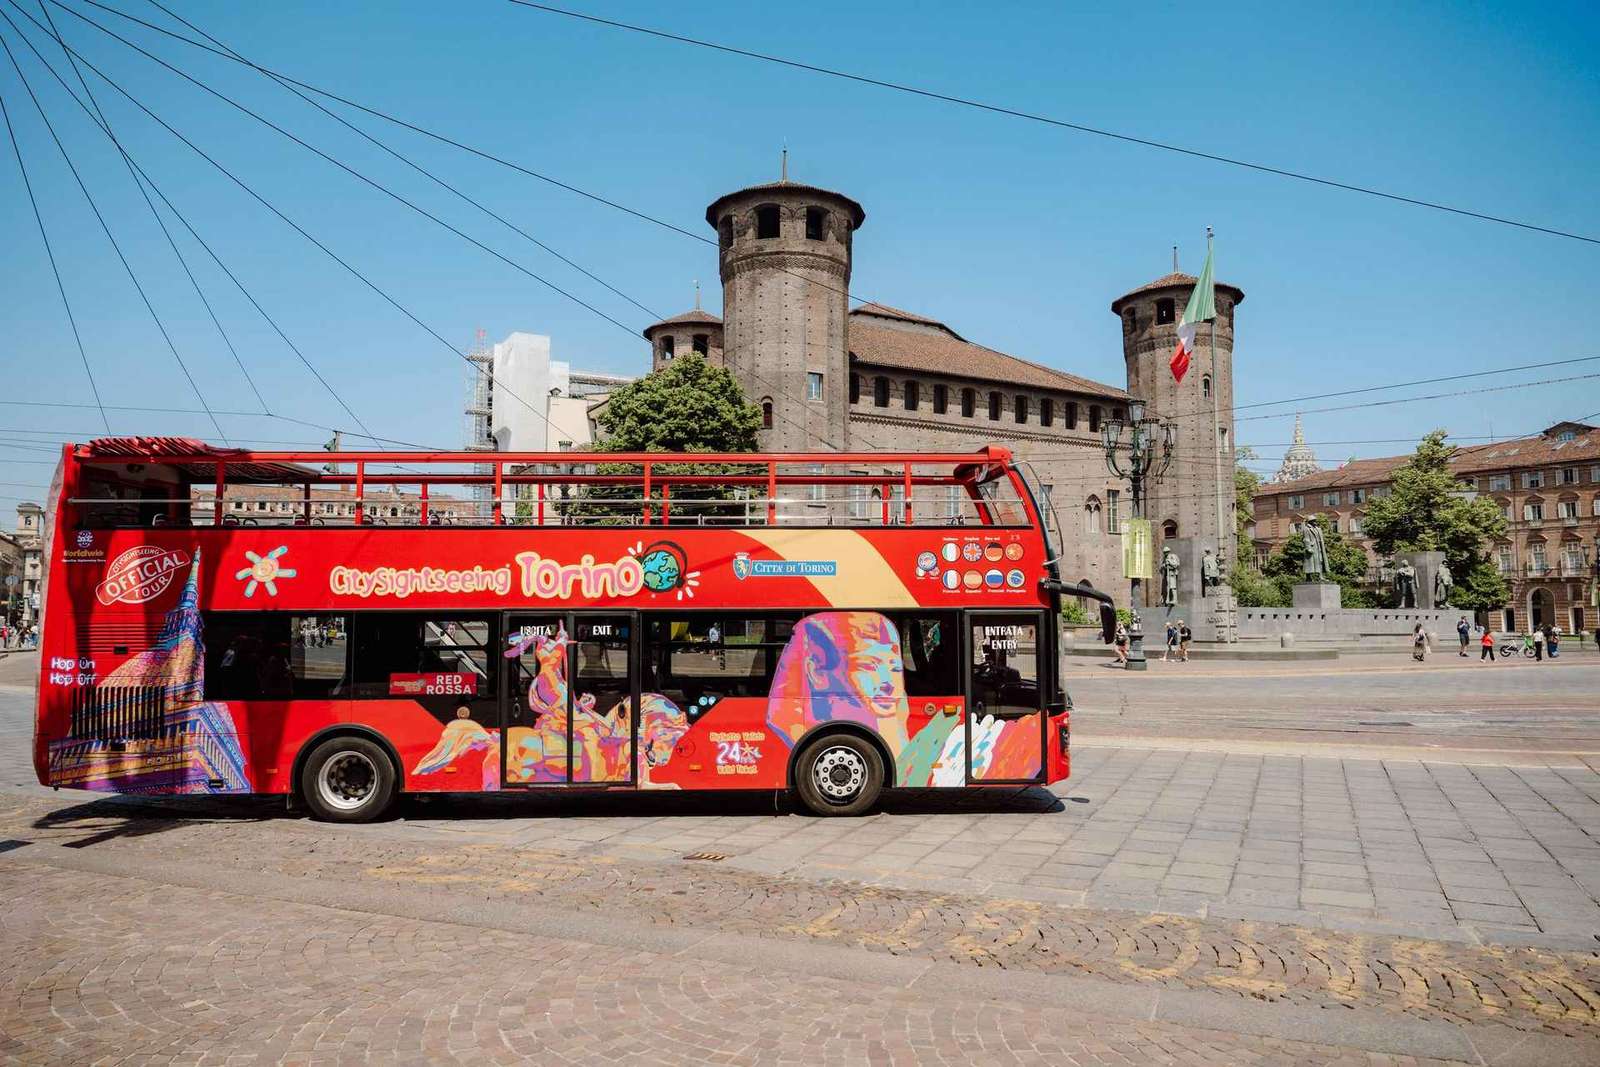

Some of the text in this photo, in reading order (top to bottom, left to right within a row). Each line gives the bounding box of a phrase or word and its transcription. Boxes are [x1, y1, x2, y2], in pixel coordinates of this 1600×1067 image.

[105, 553, 184, 598] OFFICIAL
[330, 551, 644, 599] CitySightseeing Torino
[134, 577, 169, 598] TOUR
[592, 625, 612, 636] EXIT
[991, 639, 1018, 650] ENTRY
[51, 656, 96, 671] Hop On
[50, 672, 96, 686] Hop Off
[436, 675, 462, 685] RED
[426, 685, 472, 695] ROSSA
[716, 742, 741, 764] 24
